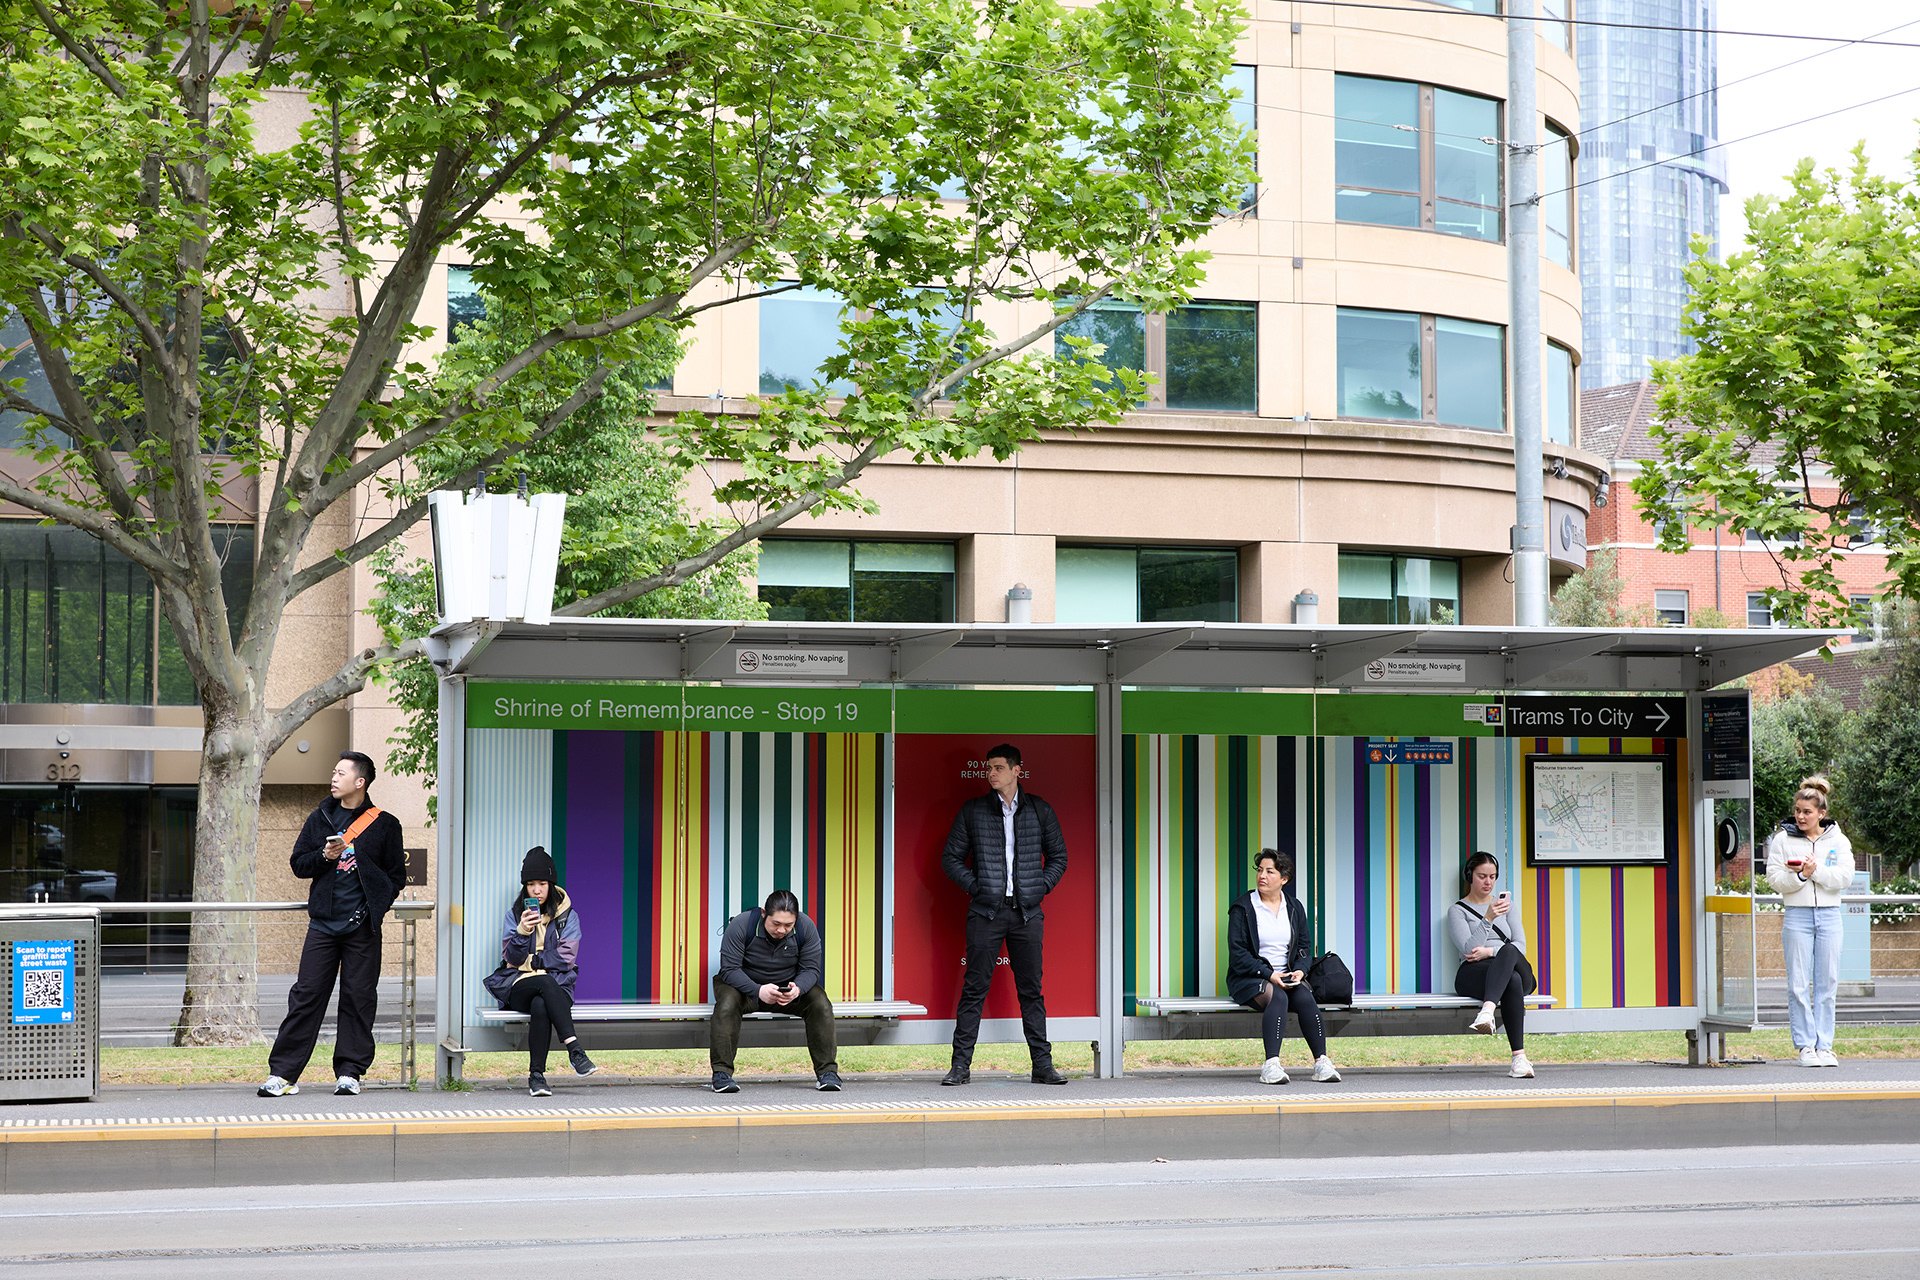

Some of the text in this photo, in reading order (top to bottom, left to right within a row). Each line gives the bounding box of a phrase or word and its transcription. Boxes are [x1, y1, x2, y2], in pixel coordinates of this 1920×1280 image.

[762, 653, 845, 664] No smoking. No vaping.
[1398, 662, 1428, 671] smoking.
[1439, 663, 1463, 671] vaping.
[494, 698, 564, 718] Shrine
[570, 699, 592, 718] of
[598, 699, 754, 720] Remembrance
[776, 702, 826, 725] Stop
[834, 702, 858, 721] 19
[1508, 707, 1634, 730] Trams To City
[967, 760, 979, 769] 90
[46, 763, 81, 781] 312
[1849, 906, 1864, 914] 4534
[16, 946, 36, 954] Scan
[47, 946, 72, 954] report
[22, 952, 66, 962] graffiti and
